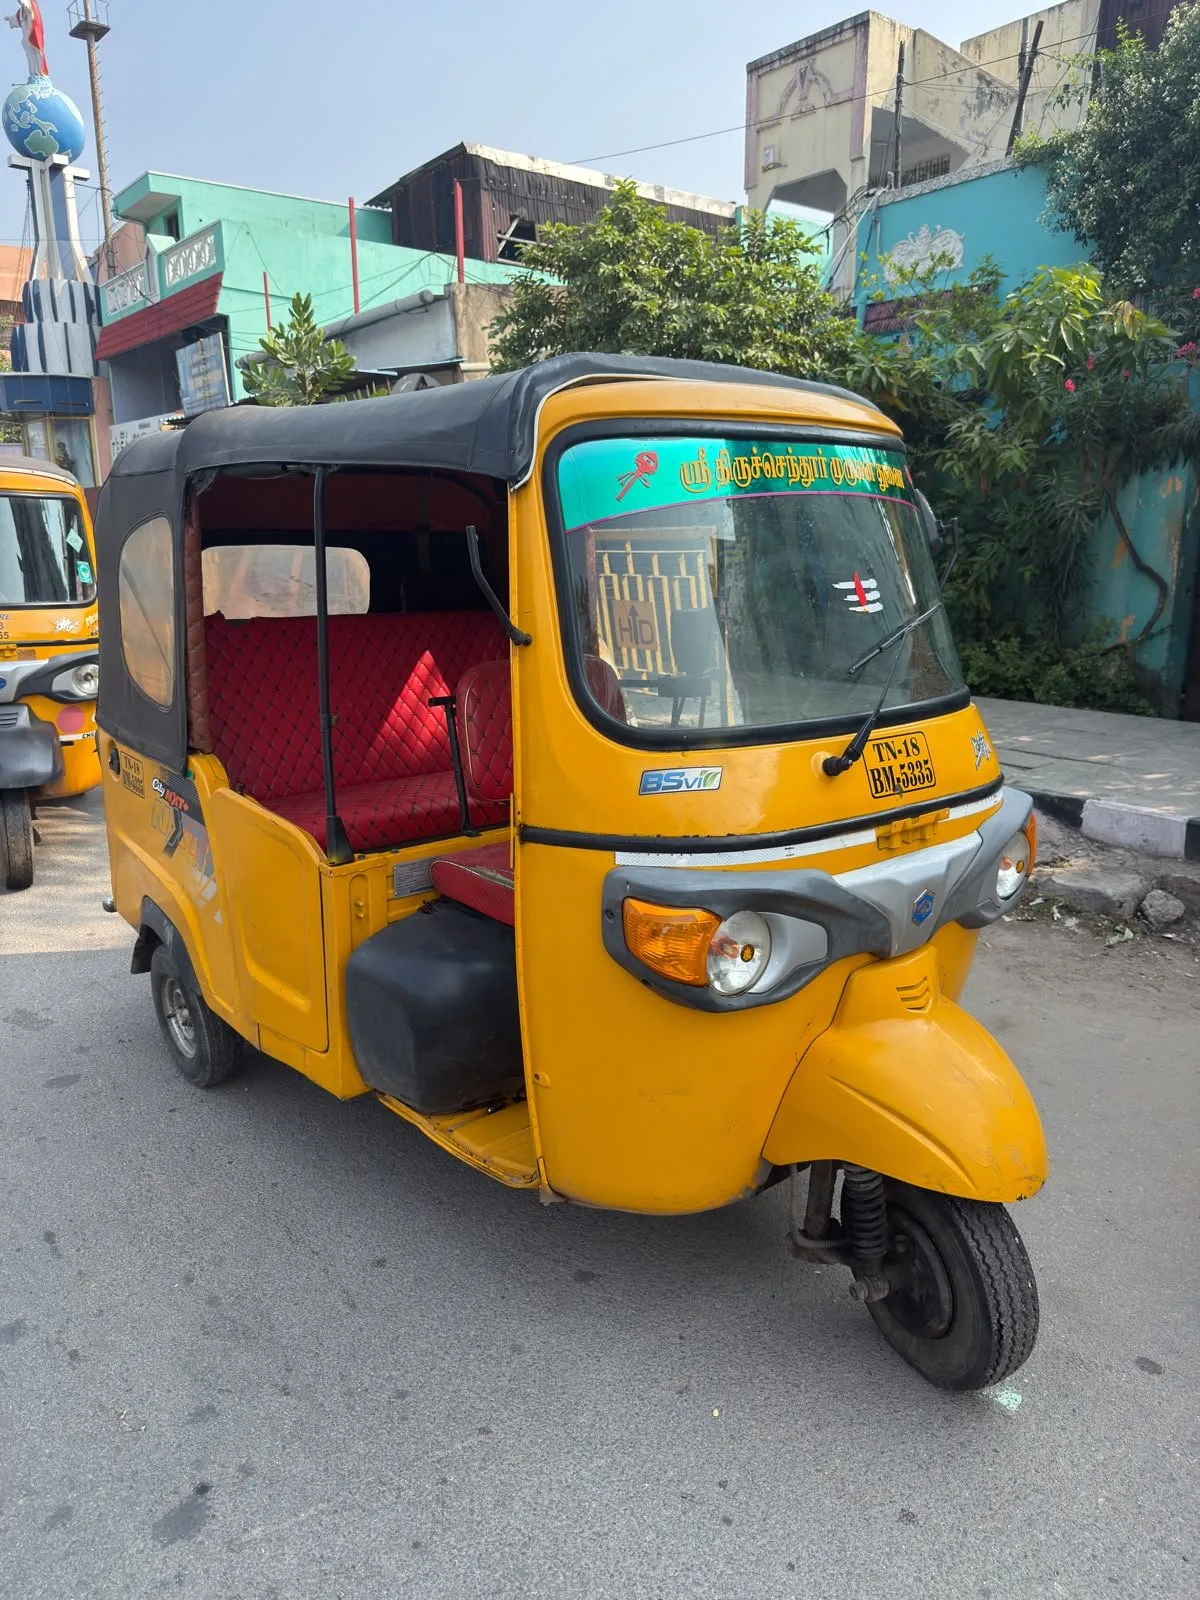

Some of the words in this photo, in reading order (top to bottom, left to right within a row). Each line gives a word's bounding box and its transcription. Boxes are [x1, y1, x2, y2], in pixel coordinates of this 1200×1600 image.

[715, 446, 828, 488] திருச்செந்தூர்
[872, 737, 920, 762] TN-18
[869, 759, 933, 794] BM-5335
